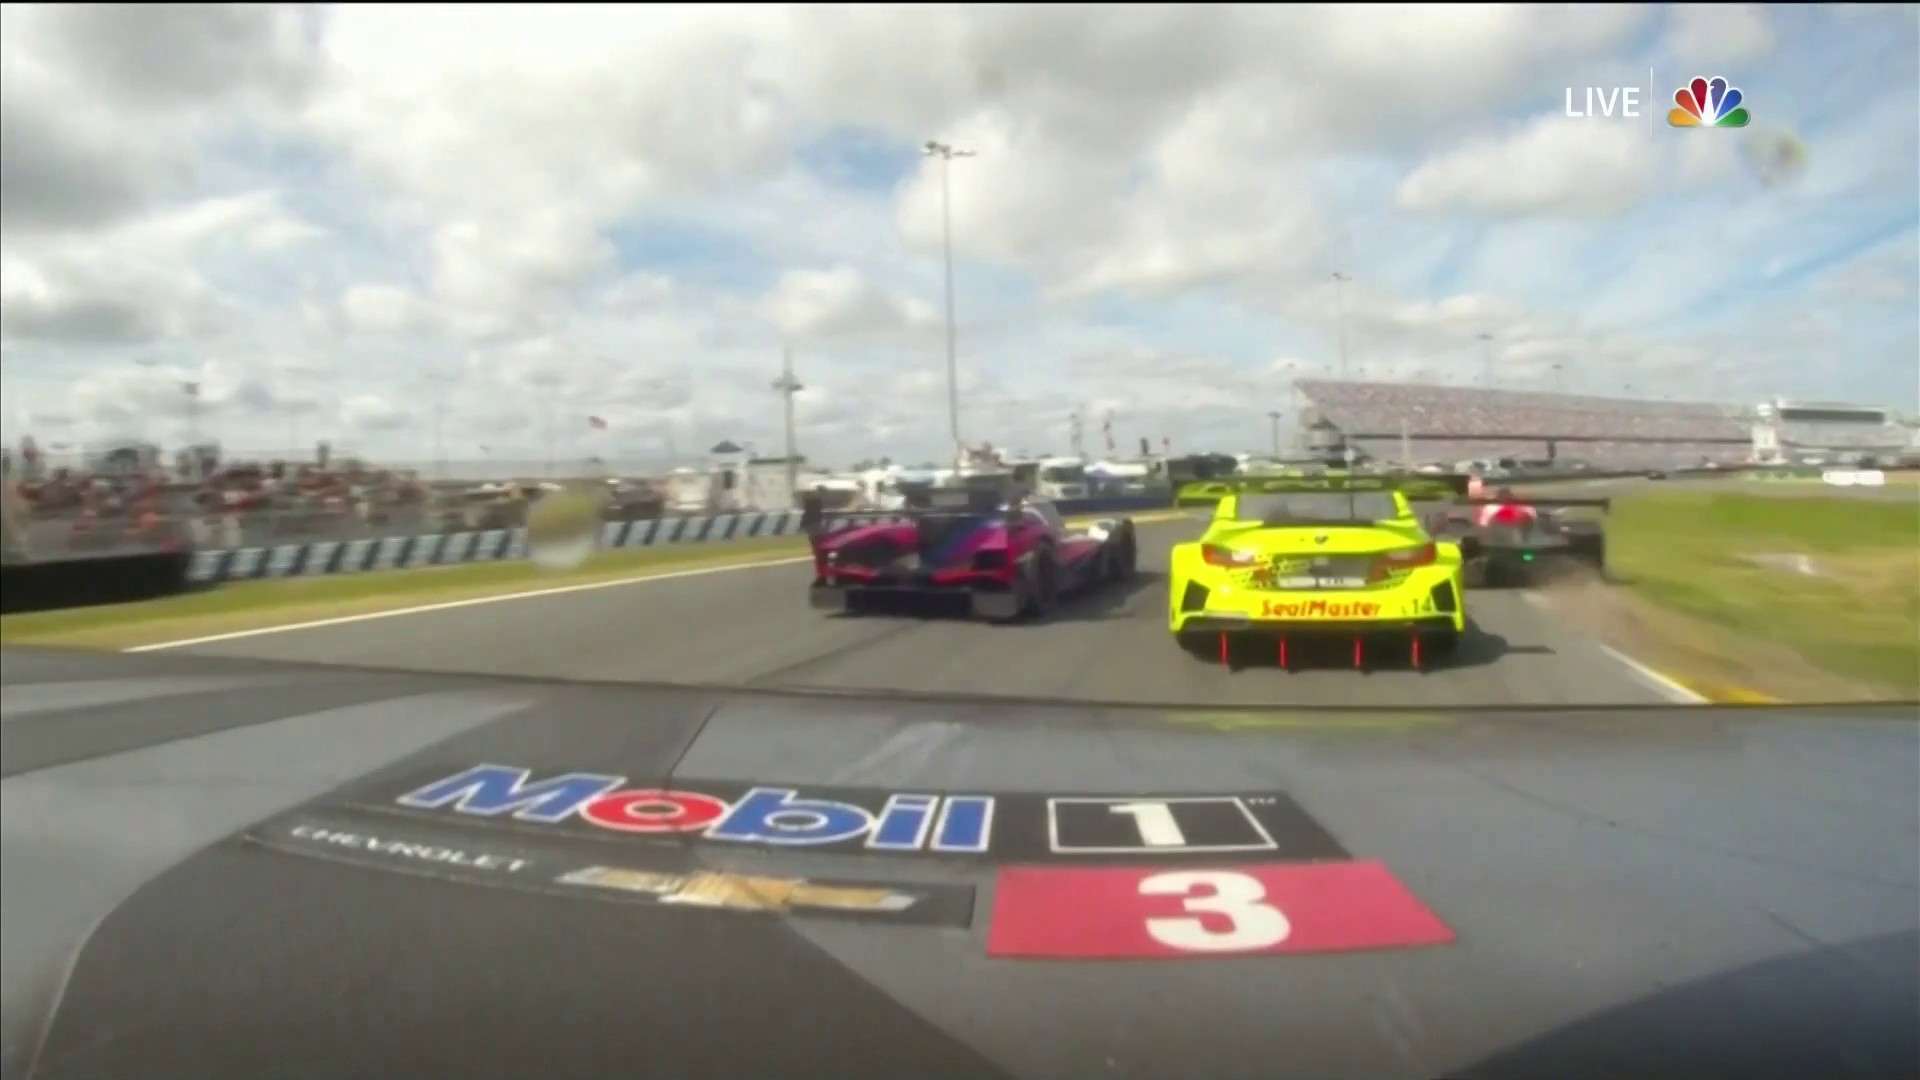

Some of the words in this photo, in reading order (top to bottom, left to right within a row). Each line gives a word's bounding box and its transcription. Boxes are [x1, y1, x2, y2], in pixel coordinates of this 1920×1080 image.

[1261, 598, 1382, 617] SealMaster
[1412, 597, 1432, 613] 14
[396, 763, 995, 853] Mobil
[1109, 800, 1186, 847] 1
[290, 824, 527, 873] CHEVROLET
[1138, 869, 1292, 952] 3
